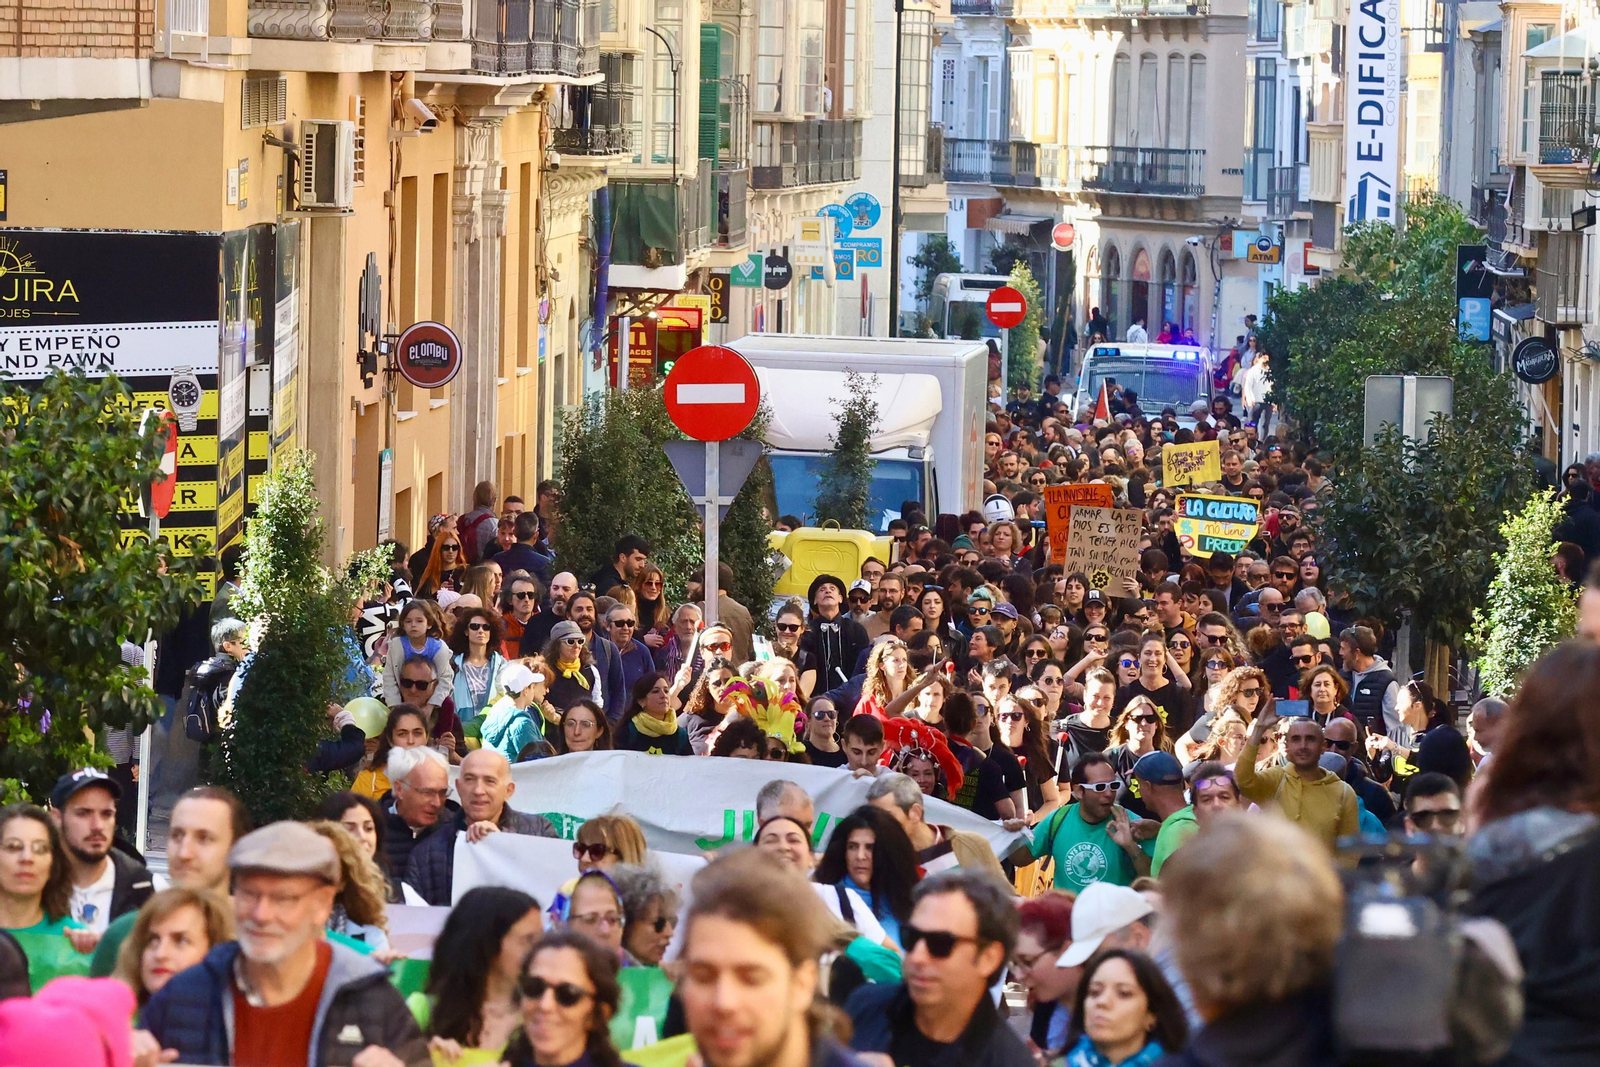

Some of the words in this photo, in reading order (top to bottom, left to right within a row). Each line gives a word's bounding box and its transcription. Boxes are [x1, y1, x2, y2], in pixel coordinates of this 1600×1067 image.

[846, 193, 866, 204] COMPRO
[866, 194, 878, 205] TODO
[837, 206, 849, 217] TODO
[857, 249, 880, 263] RO
[1251, 253, 1274, 261] ATM
[2, 279, 80, 303] JIRA
[19, 330, 121, 352] EMPEÑO
[613, 348, 652, 356] TACOS
[0, 355, 38, 369] ND
[48, 352, 115, 368] PAWN
[1073, 508, 1103, 521] ARMAR
[1111, 510, 1122, 522] LA
[1185, 499, 1204, 517] LA
[1206, 501, 1257, 522] CULTURA
[1073, 520, 1092, 532] DIOS
[1097, 522, 1111, 534] ES
[1089, 535, 1117, 548] TENER
[1204, 537, 1248, 553] PRECIO
[1068, 546, 1086, 558] TAN
[1078, 843, 1092, 851] FOR
